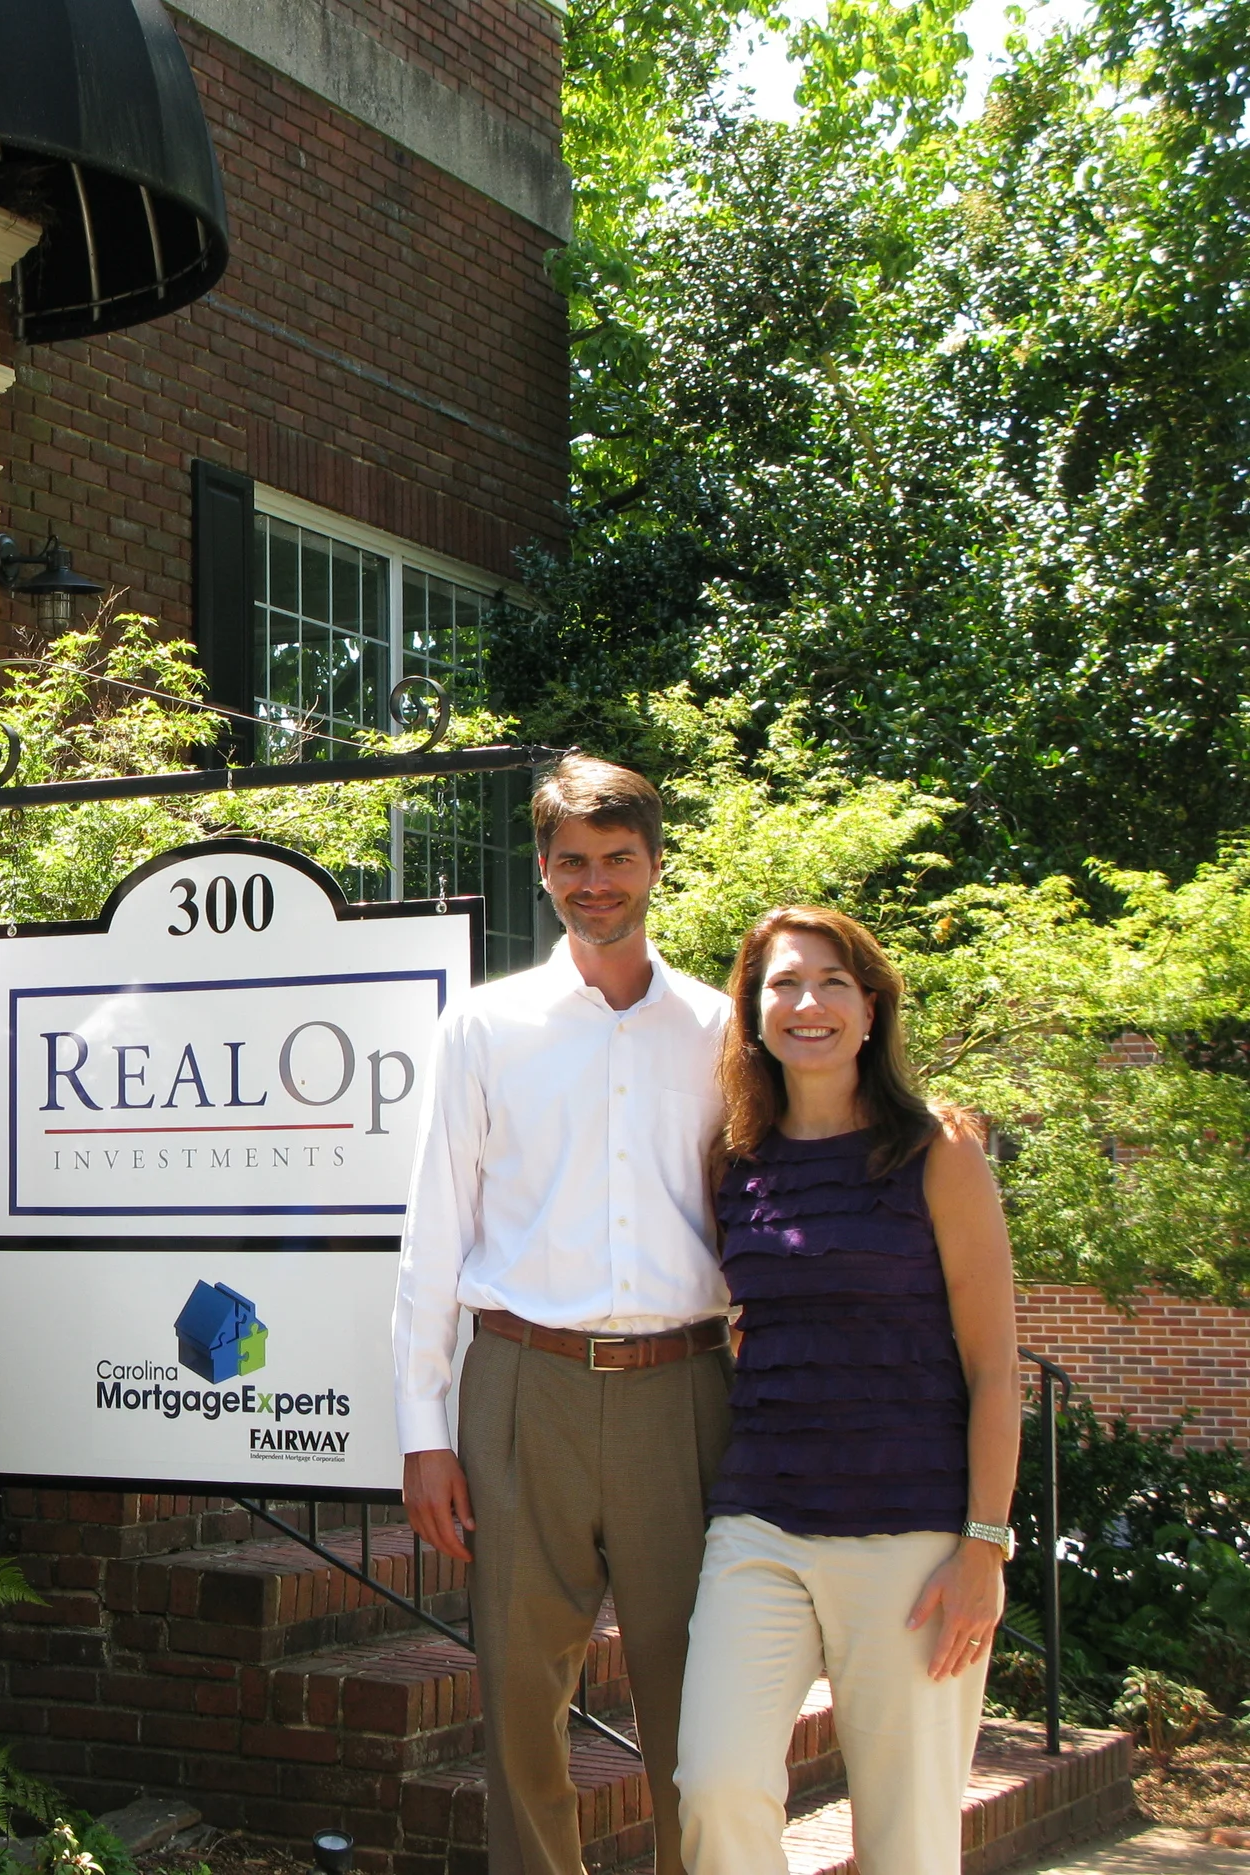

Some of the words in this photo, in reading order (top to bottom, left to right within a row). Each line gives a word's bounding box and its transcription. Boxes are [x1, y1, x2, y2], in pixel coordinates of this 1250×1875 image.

[167, 872, 275, 937] 300
[53, 1144, 347, 1171] INVESTMENTS
[96, 1359, 179, 1381] Carolina
[96, 1381, 350, 1422] MortgageExperts
[250, 1428, 350, 1453] FAIRWAY
[250, 1453, 284, 1461] Independent
[285, 1454, 311, 1463] Mortgage
[312, 1455, 345, 1463] Corporation
